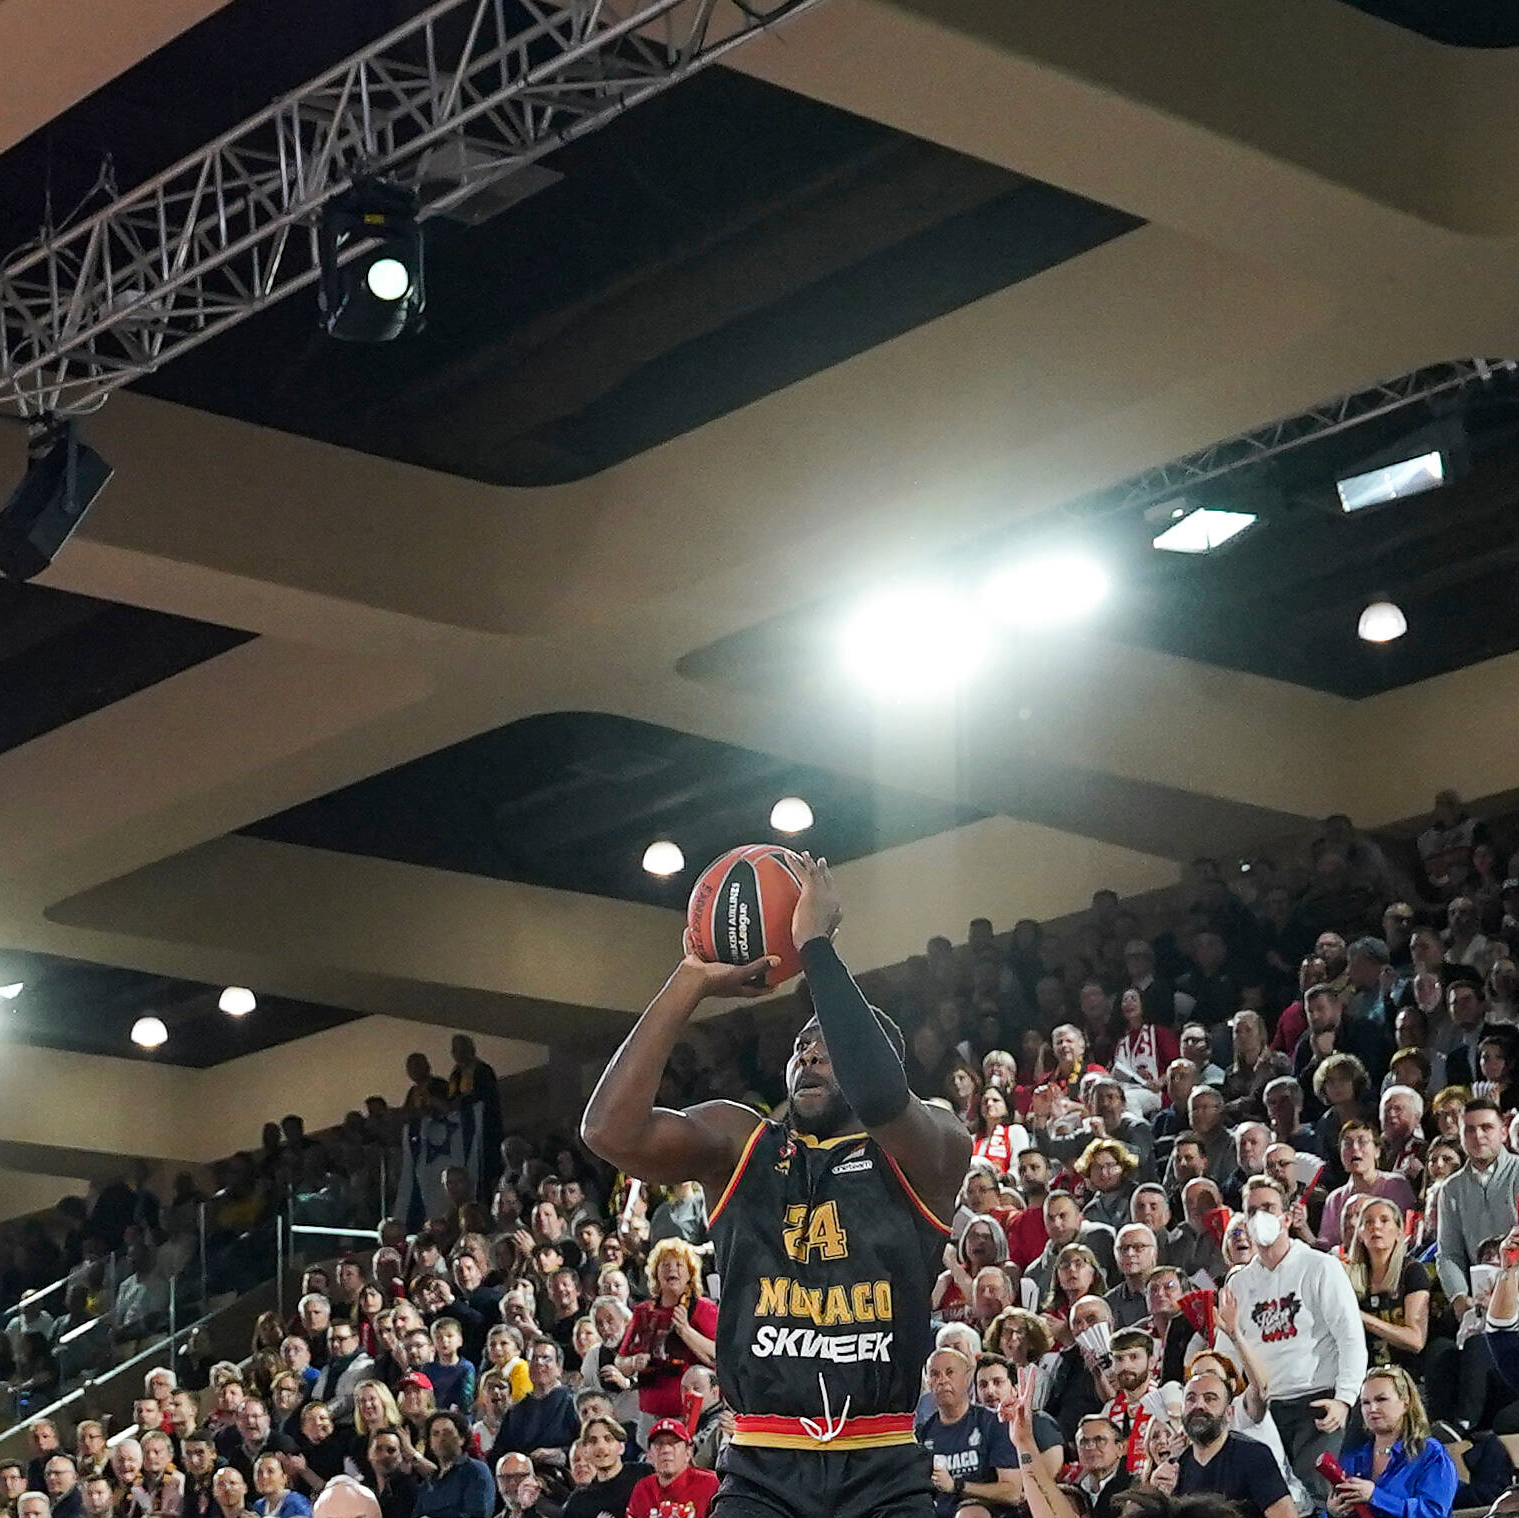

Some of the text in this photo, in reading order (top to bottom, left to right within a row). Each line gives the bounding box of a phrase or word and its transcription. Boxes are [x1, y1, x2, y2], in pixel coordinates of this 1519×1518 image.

[727, 927, 739, 961] URKISH
[738, 902, 751, 960] uroLeague
[783, 1200, 849, 1264] 24
[754, 1276, 894, 1326] MONACO
[752, 1325, 893, 1363] SKWEEK
